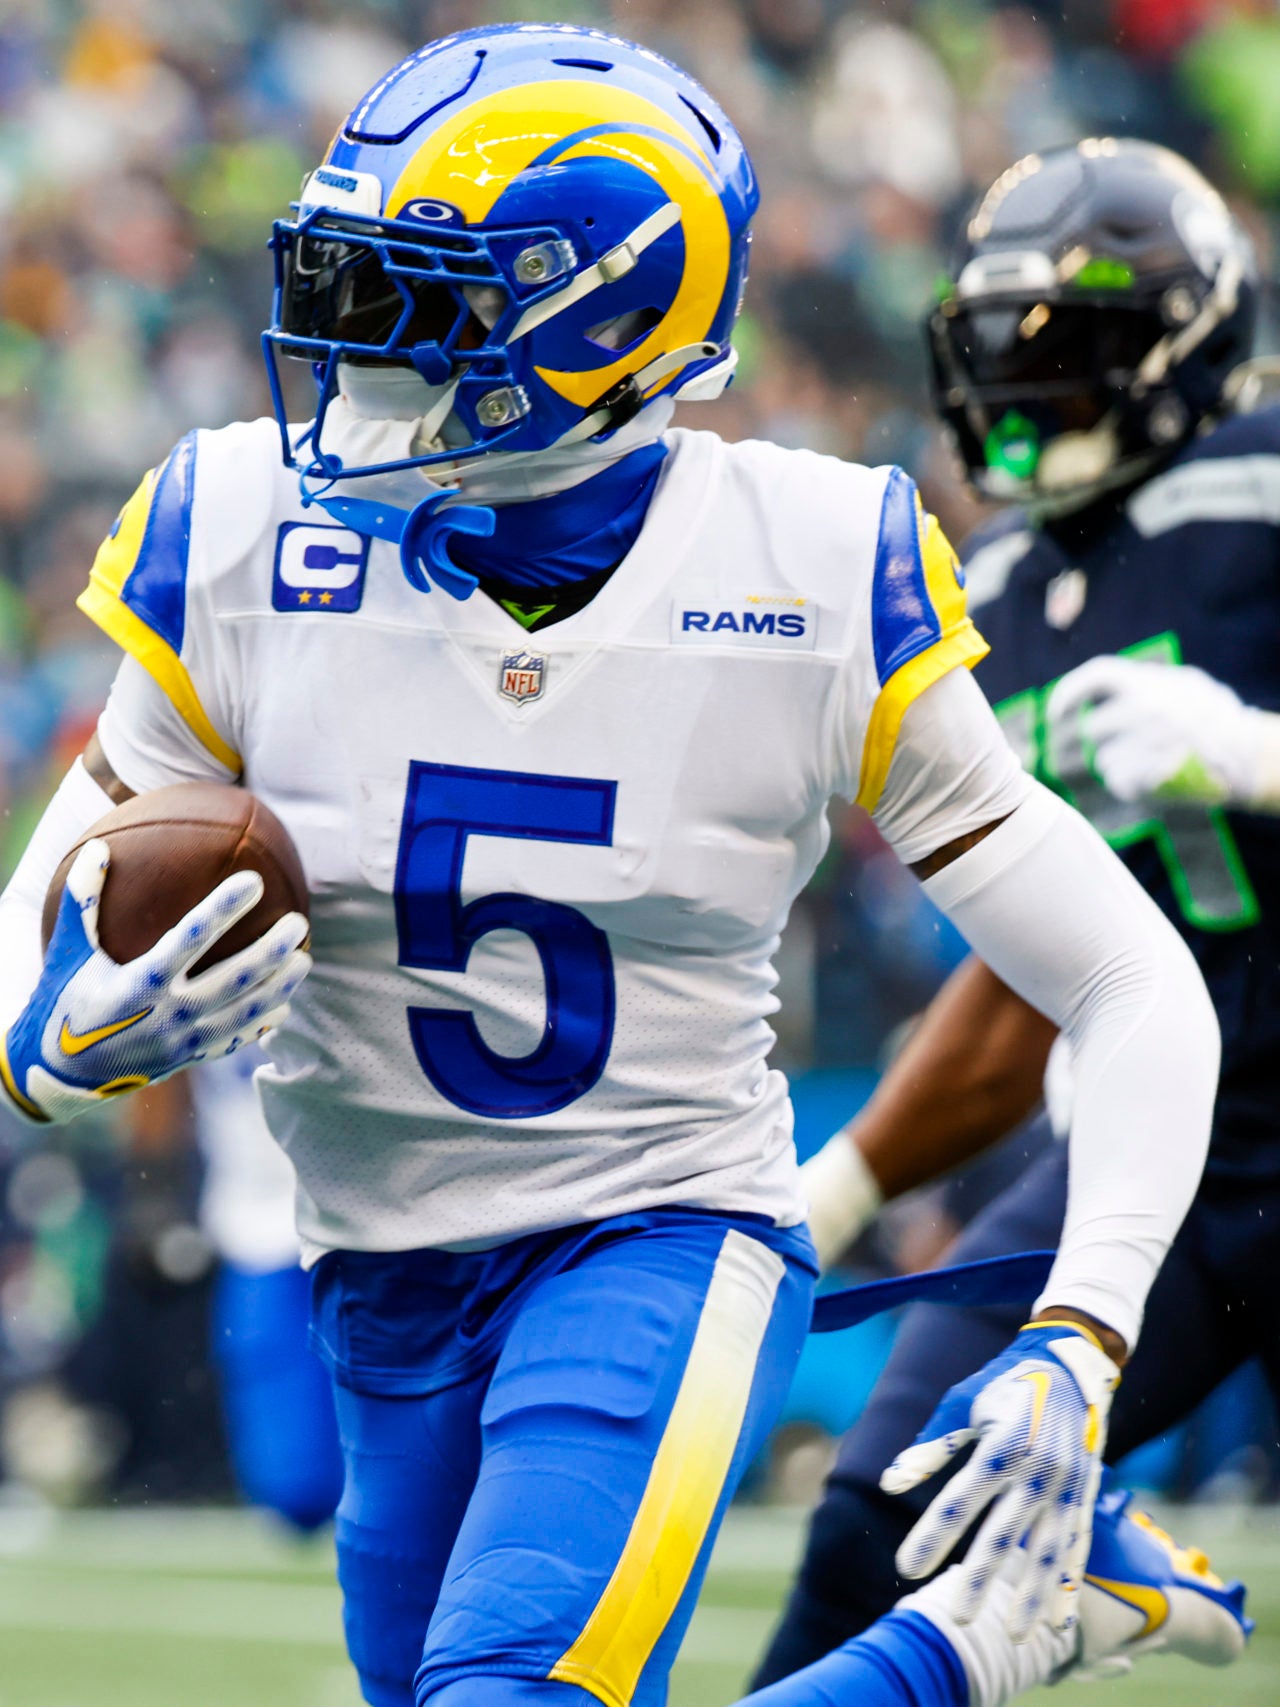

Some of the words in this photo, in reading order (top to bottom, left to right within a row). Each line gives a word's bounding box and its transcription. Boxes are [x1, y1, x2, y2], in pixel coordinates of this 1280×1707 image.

[280, 526, 363, 589] C
[682, 611, 806, 637] RAMS
[504, 671, 539, 694] NFL
[394, 759, 618, 1119] 5
